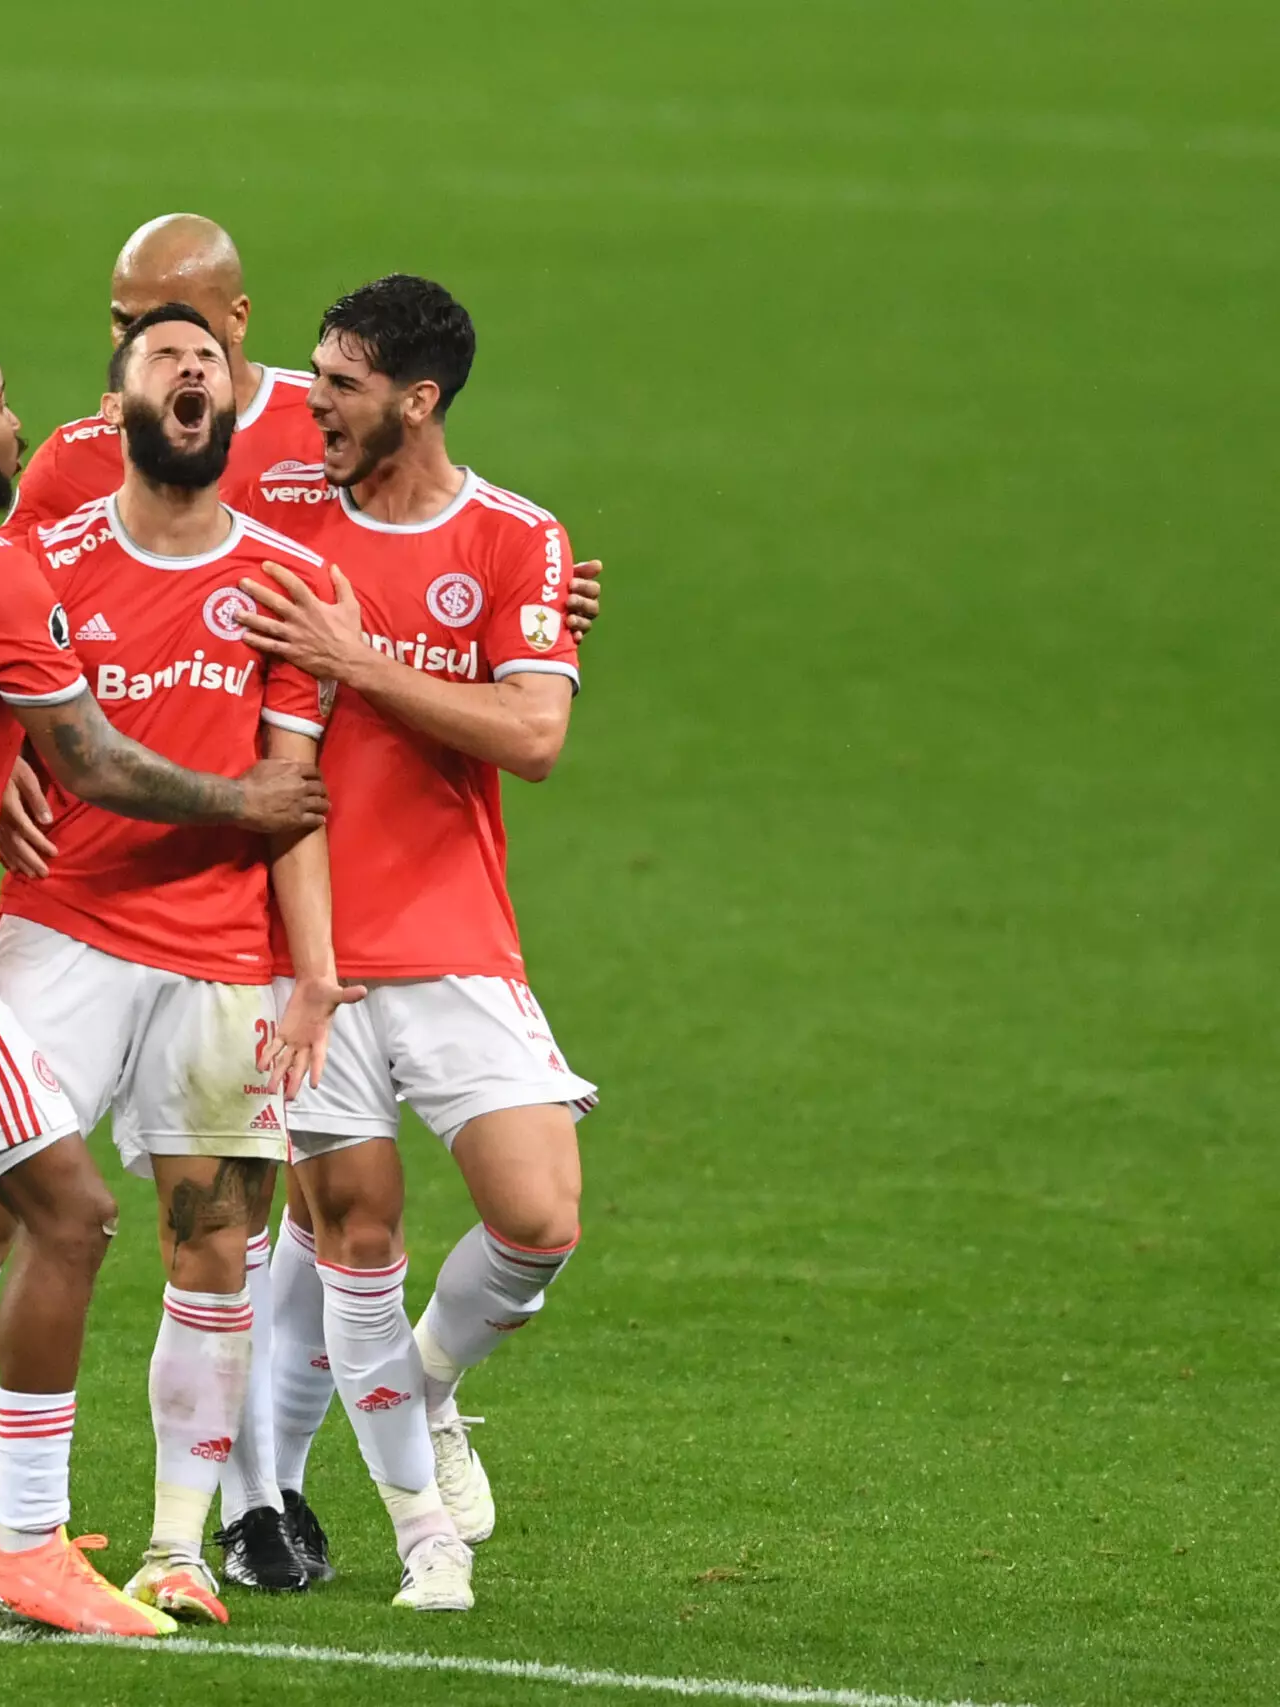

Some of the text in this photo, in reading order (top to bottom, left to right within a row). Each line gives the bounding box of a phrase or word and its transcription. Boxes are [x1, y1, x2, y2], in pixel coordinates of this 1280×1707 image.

[261, 486, 322, 504] vero
[45, 533, 97, 570] vero
[545, 528, 562, 585] vero
[97, 649, 255, 700] Banrisul
[361, 632, 477, 680] nrisul
